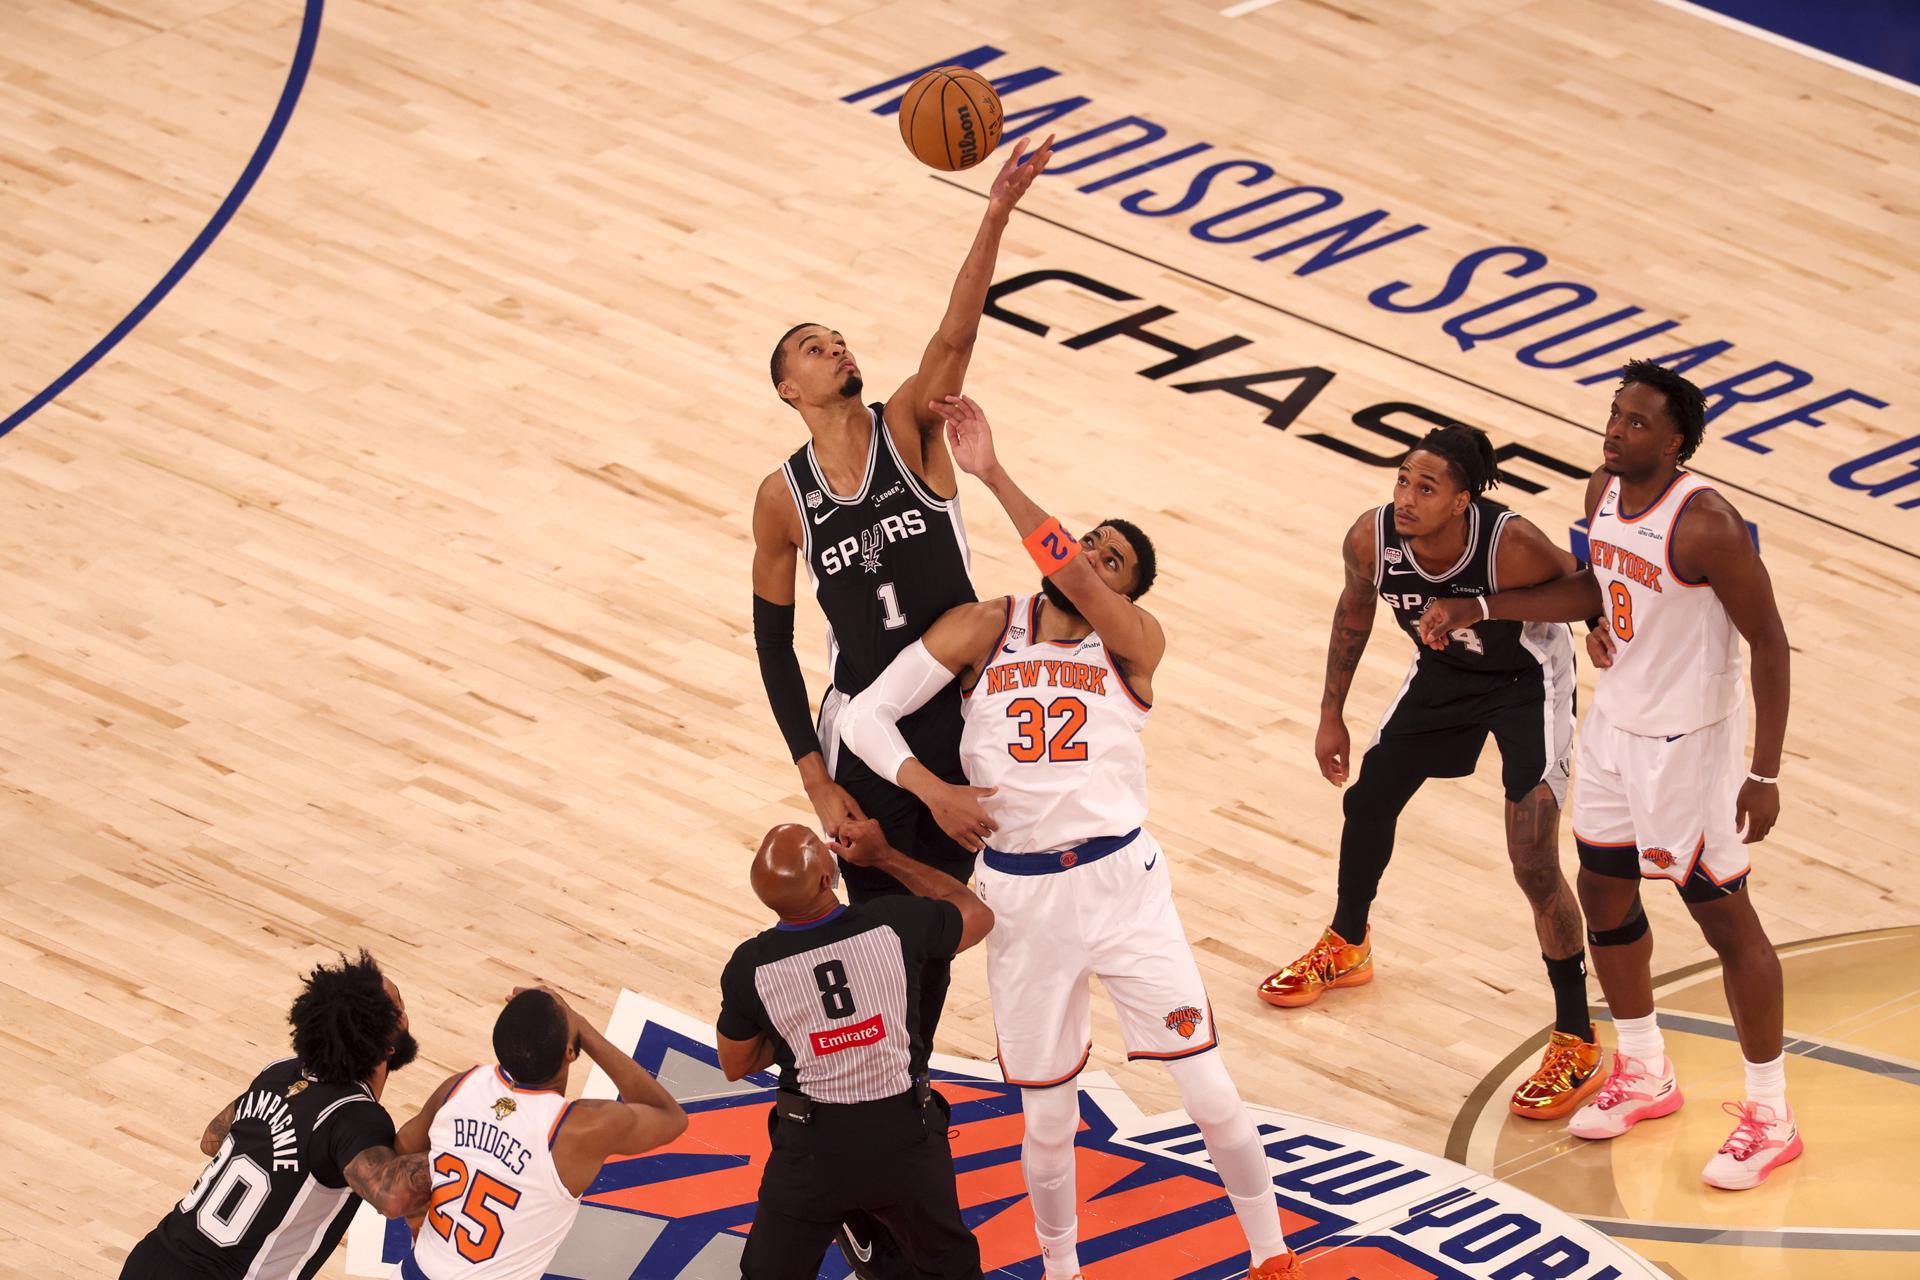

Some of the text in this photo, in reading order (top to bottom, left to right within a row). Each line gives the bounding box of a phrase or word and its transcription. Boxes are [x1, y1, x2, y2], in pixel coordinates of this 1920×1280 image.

[958, 105, 978, 168] Wilson
[838, 44, 1428, 277] MADISON
[1368, 245, 1890, 455] SQUARE
[983, 269, 1593, 513] CHASE
[876, 485, 901, 503] LEDGER
[821, 509, 927, 575] SPURS
[1616, 547, 1663, 594] YORK
[876, 582, 907, 631] 1
[1608, 579, 1634, 643] 8
[986, 660, 1108, 697] NEW YORK
[1006, 696, 1088, 763] 32
[813, 959, 856, 1020] 8
[1166, 1006, 1203, 1029] KNICKS
[818, 1024, 879, 1049] Emirates
[454, 1118, 531, 1175] BRIDGES
[428, 1151, 522, 1264] 25
